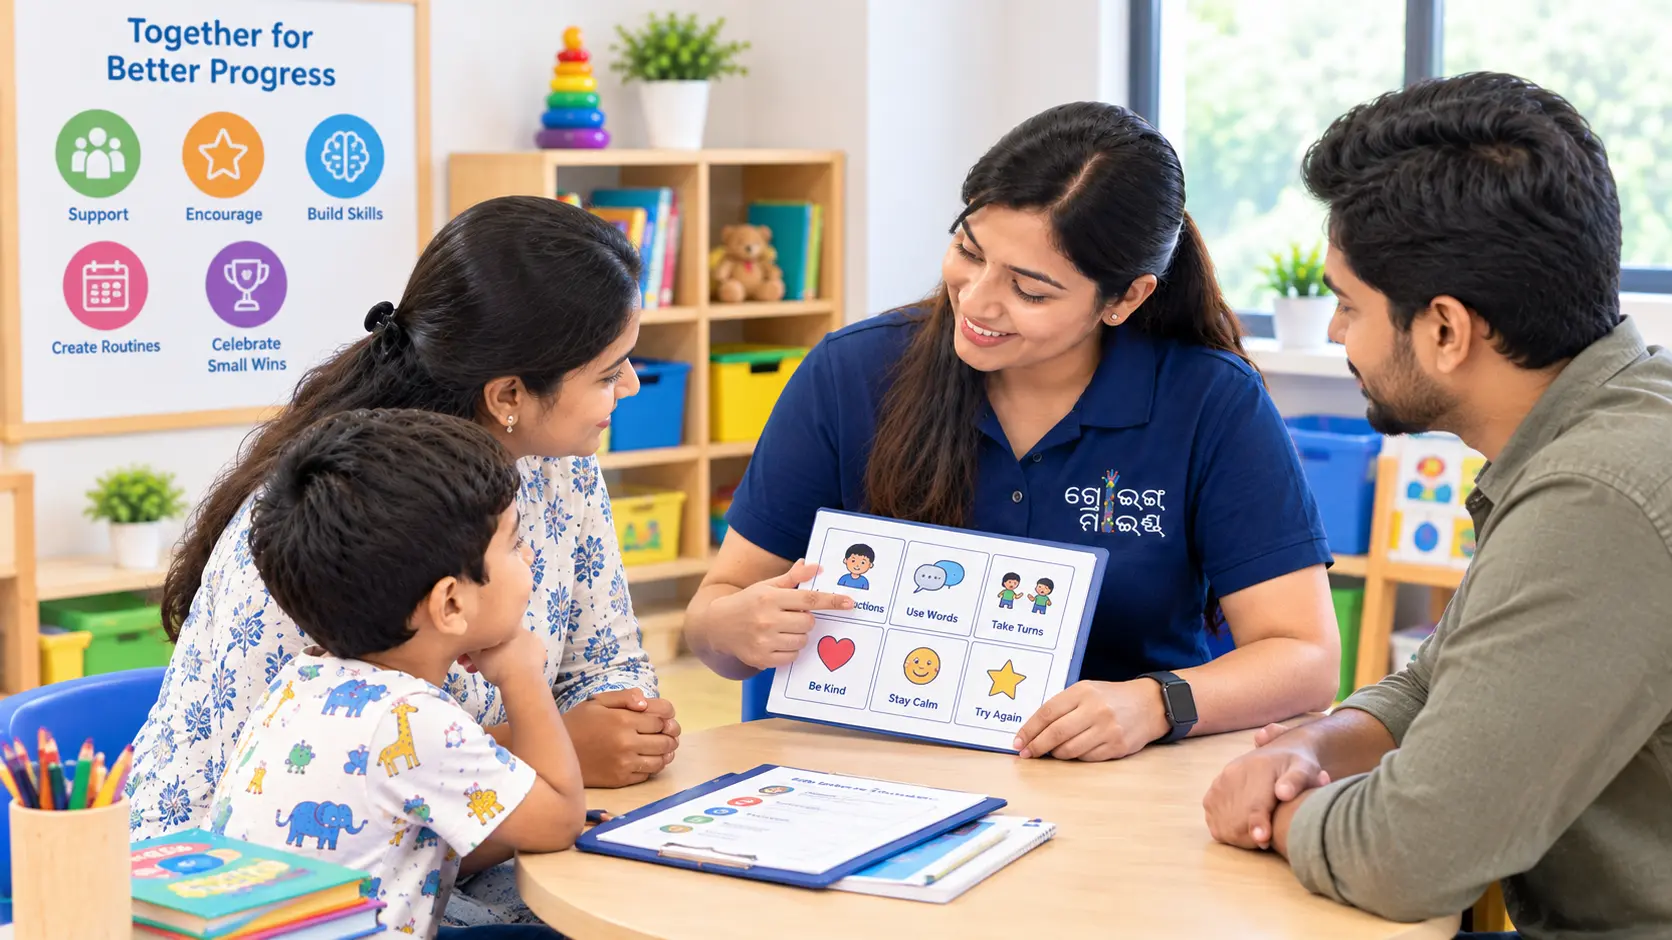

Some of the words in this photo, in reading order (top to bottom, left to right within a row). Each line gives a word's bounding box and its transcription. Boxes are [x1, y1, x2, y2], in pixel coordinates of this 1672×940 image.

[128, 17, 262, 51] Together
[271, 22, 313, 49] for
[107, 55, 200, 83] Better
[210, 58, 336, 92] Progress
[68, 206, 129, 224] Support
[185, 206, 263, 224] Encourage
[307, 206, 344, 221] Build
[347, 206, 384, 221] Skills
[51, 340, 98, 355] Create
[101, 339, 161, 354] Routines
[211, 337, 282, 352] Celebrate
[207, 358, 248, 373] Small
[251, 357, 287, 372] Wins
[906, 606, 925, 619] Use
[927, 609, 959, 624] Words
[991, 619, 1015, 632] Take
[1017, 623, 1044, 637] Turns
[808, 680, 822, 692] Be
[823, 683, 847, 696] Kind
[888, 693, 912, 708] Stay
[912, 697, 939, 710] Calm
[975, 706, 992, 721] Try
[992, 709, 1023, 724] Again
